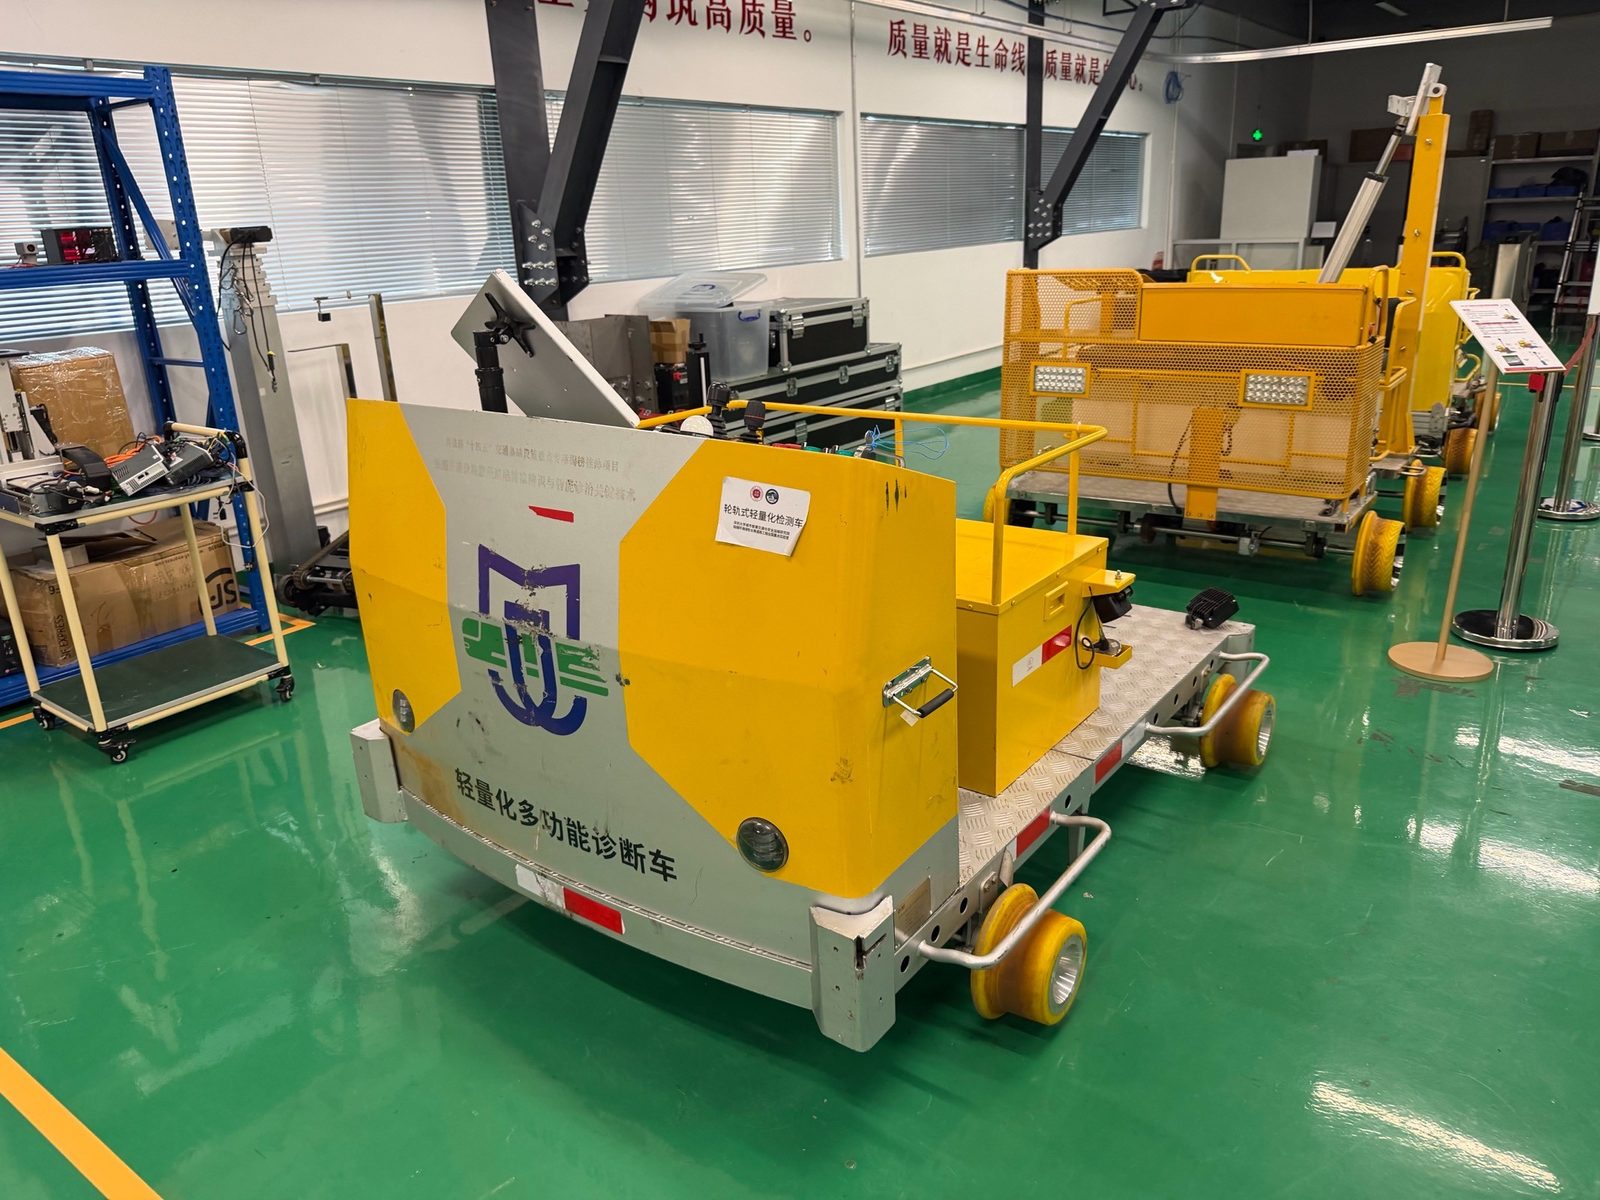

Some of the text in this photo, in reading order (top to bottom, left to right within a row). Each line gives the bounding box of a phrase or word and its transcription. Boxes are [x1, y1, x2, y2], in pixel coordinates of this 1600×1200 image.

[887, 19, 1026, 76] 质量就是生命线
[723, 503, 804, 529] 轮轨式轻量化检测车
[455, 767, 677, 883] 轻量化多功能诊断车
